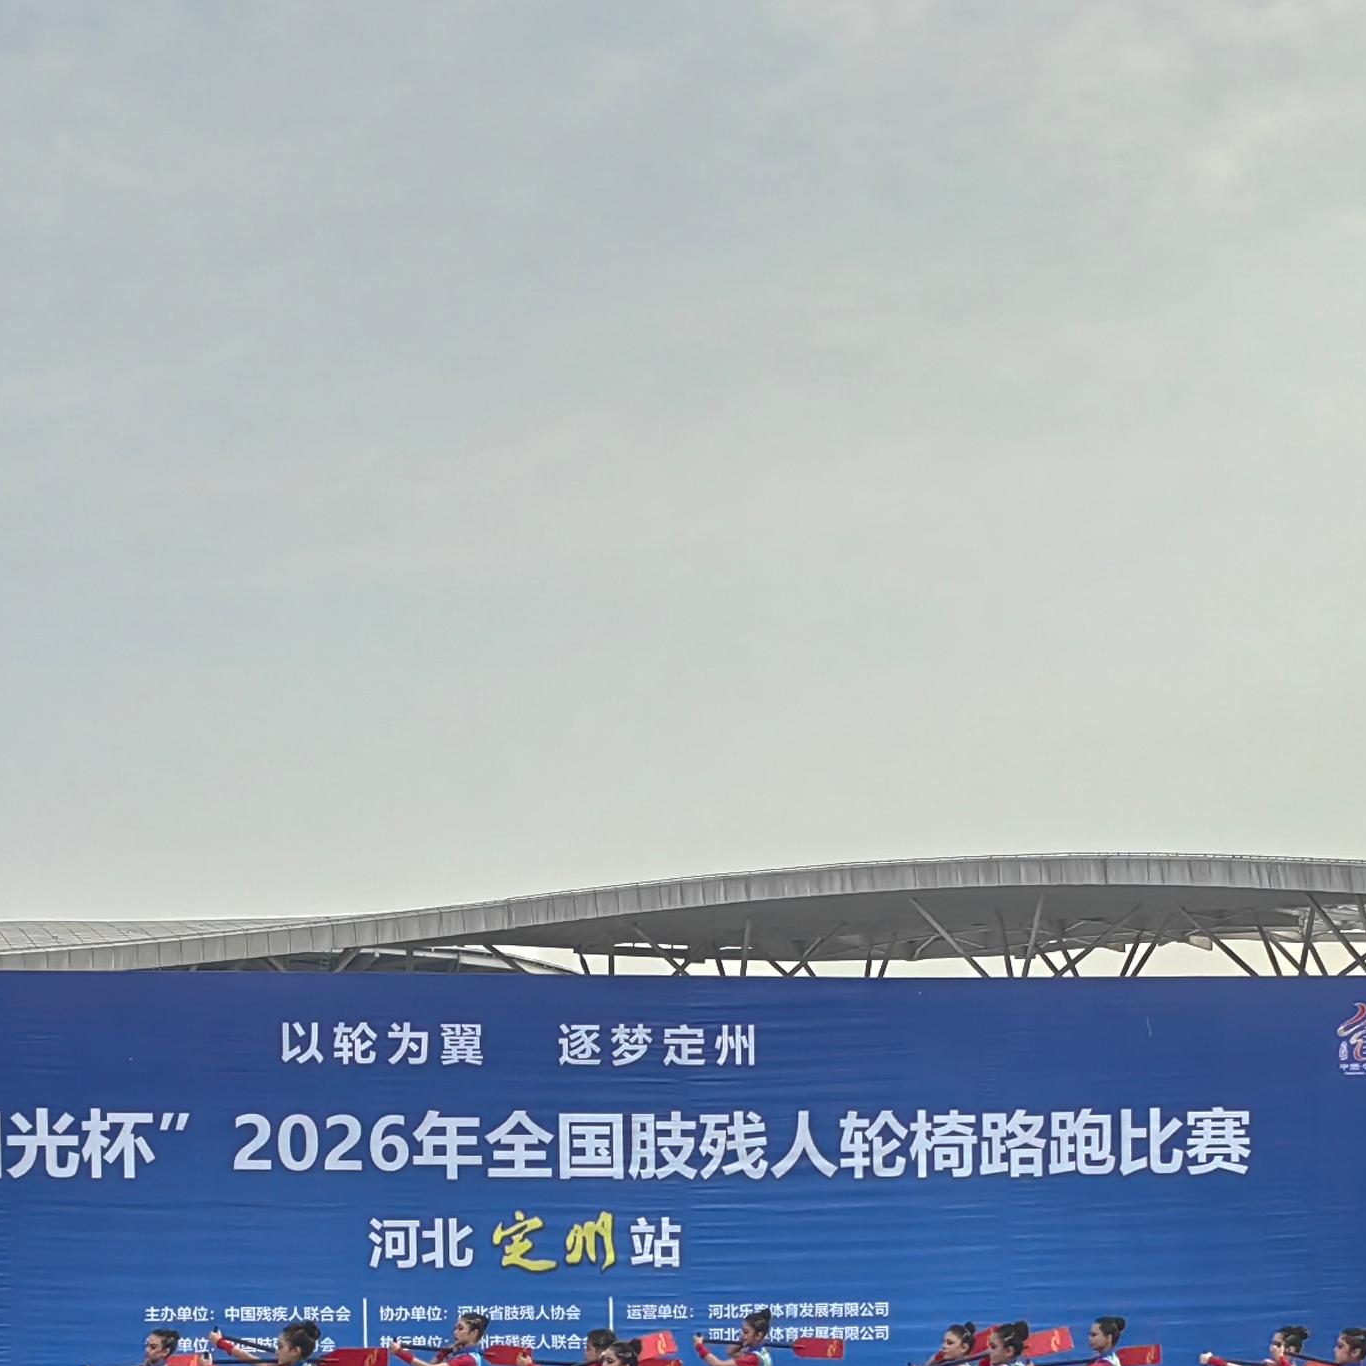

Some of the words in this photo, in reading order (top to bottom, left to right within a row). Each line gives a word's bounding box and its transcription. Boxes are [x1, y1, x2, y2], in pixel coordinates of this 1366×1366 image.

[280, 1021, 484, 1066] 以轮为翼
[559, 1023, 756, 1067] 逐梦定州
[234, 1106, 1252, 1180] 2026年全国肢残人轮椅路跑比赛
